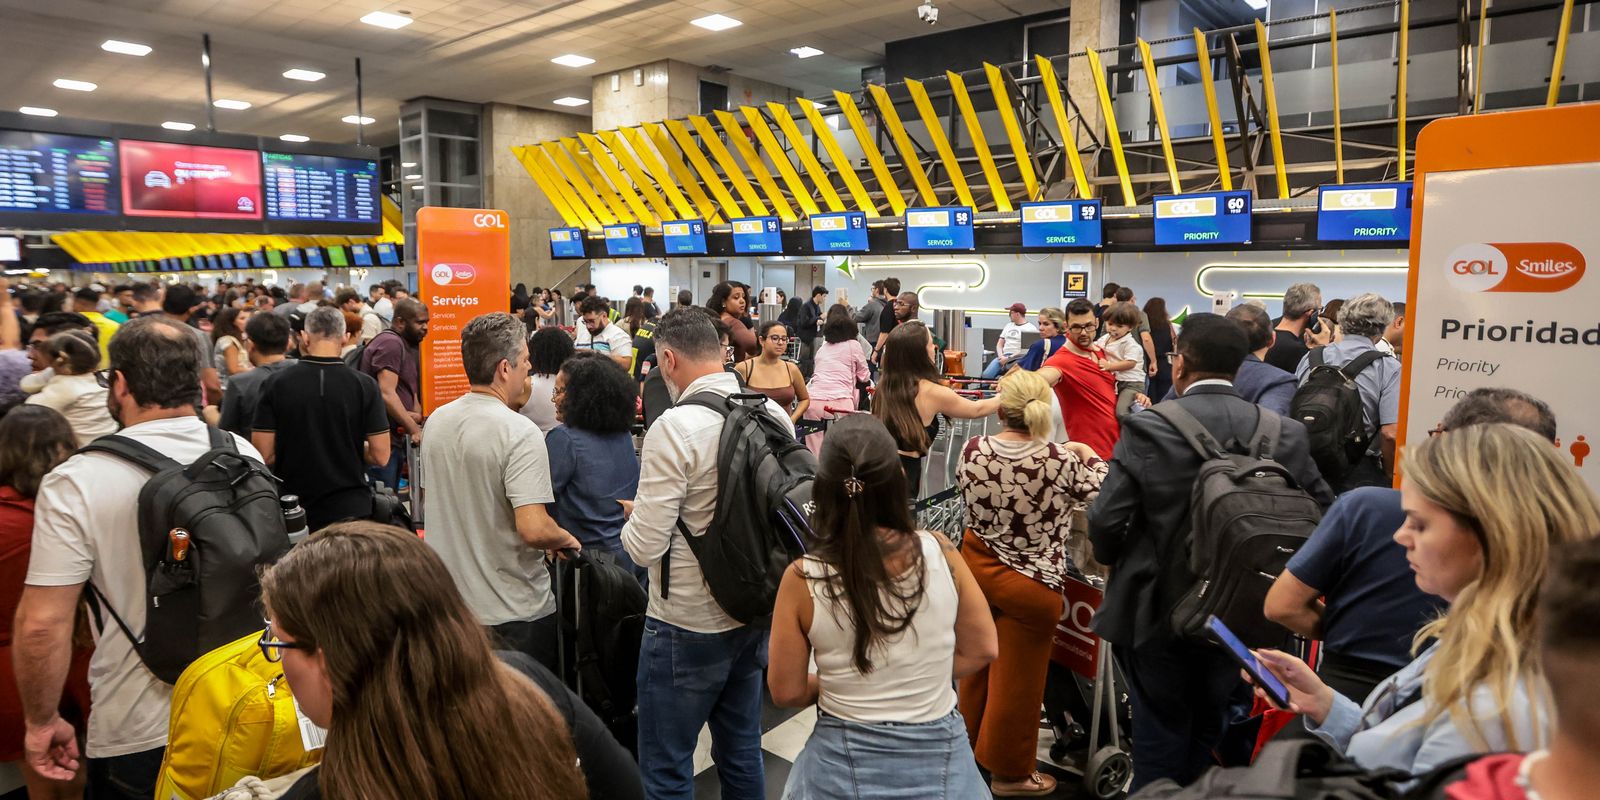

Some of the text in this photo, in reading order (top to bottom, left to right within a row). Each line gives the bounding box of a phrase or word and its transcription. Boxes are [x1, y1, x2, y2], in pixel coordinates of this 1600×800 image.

[1227, 198, 1244, 210] 60
[1340, 193, 1375, 207] GOL
[1081, 206, 1096, 217] 59
[1171, 203, 1200, 214] GOL
[473, 213, 505, 228] GOL
[852, 217, 862, 226] 57
[956, 212, 968, 222] 58
[693, 224, 701, 232] 55
[767, 221, 777, 230] 56
[1184, 231, 1219, 241] PRIORITY
[1353, 227, 1398, 236] PRIORITY
[1045, 235, 1076, 244] SERVICES
[1452, 258, 1577, 278] GOL Smiles
[434, 270, 450, 279] GOL
[432, 295, 479, 308] Serviços
[432, 312, 456, 320] Services
[432, 324, 457, 332] Servicios
[1440, 318, 1600, 346] Prioridad
[1436, 357, 1501, 377] Priority
[1434, 385, 1469, 400] Prio
